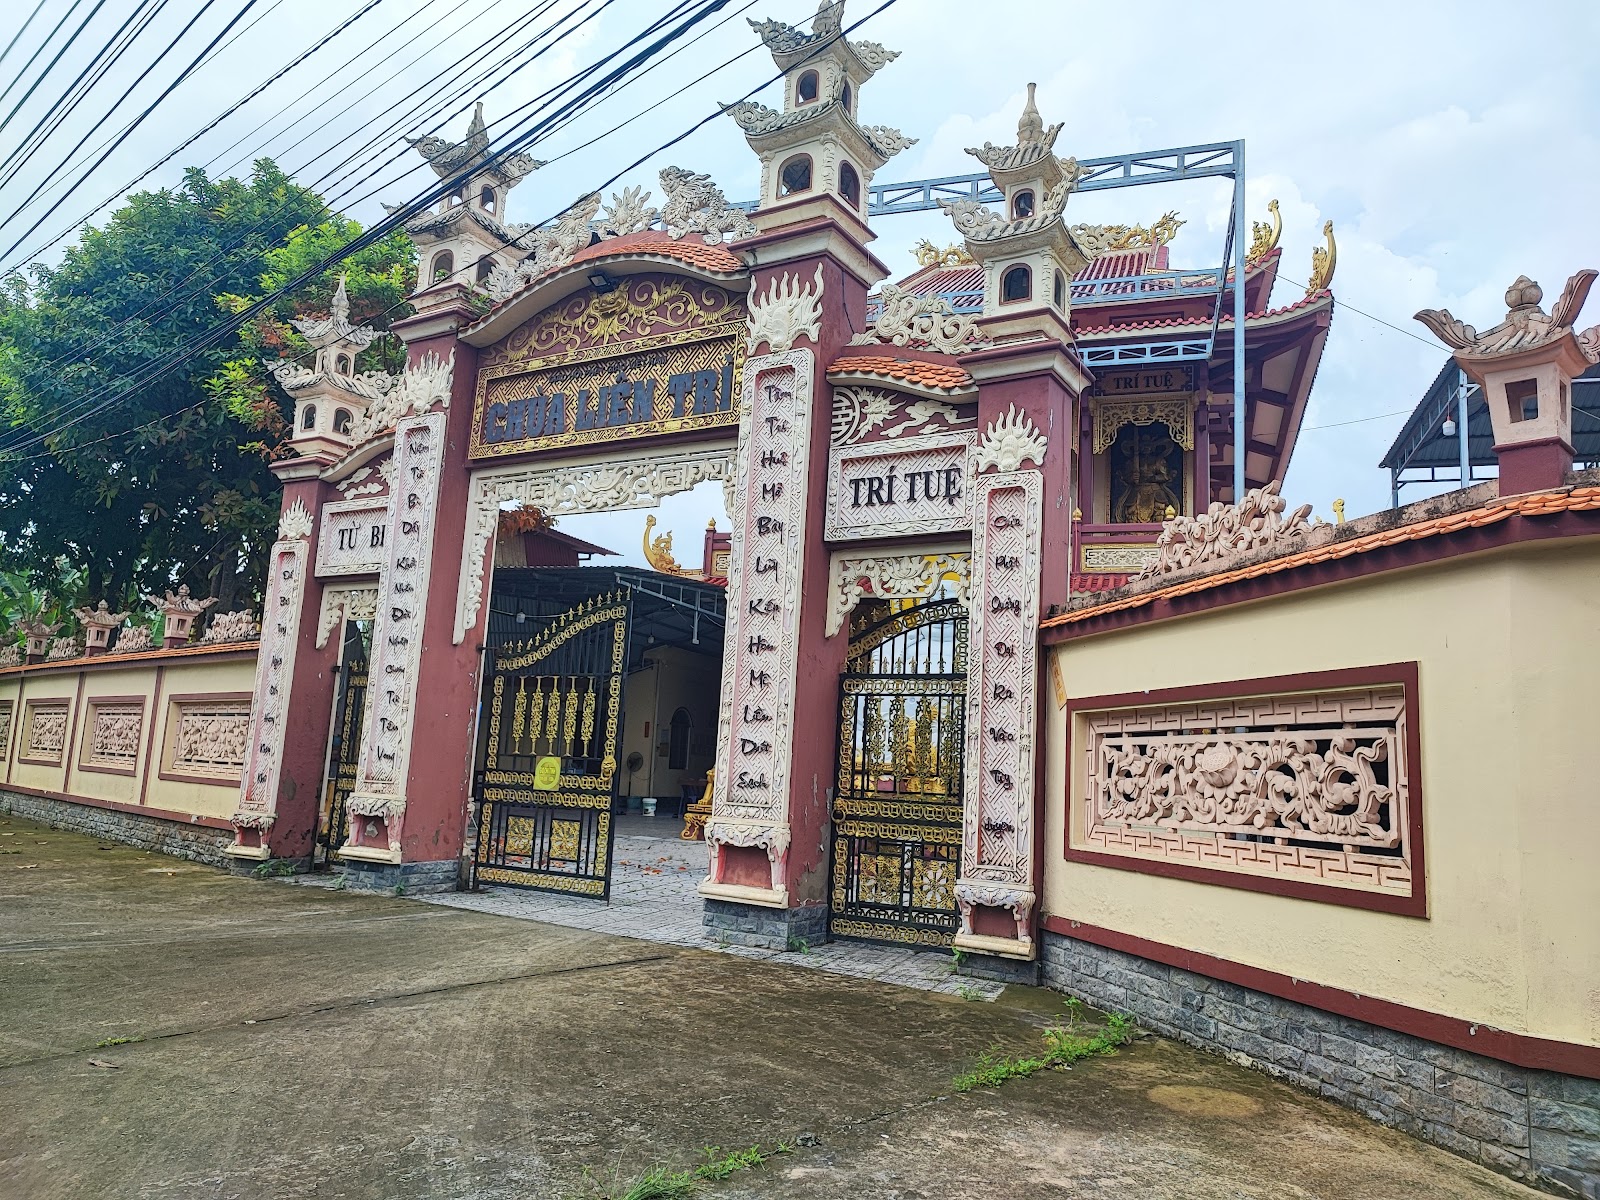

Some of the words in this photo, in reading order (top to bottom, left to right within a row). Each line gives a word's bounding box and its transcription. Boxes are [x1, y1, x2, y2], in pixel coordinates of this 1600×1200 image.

[1113, 373, 1140, 390] TRÍ
[1143, 371, 1174, 389] TUỆ
[485, 385, 566, 443] CHÙA
[574, 372, 656, 432] LIÊN
[850, 465, 899, 509] TRÍ
[904, 463, 962, 506] TUỆ
[338, 520, 361, 551] TỪ
[369, 524, 386, 548] BI
